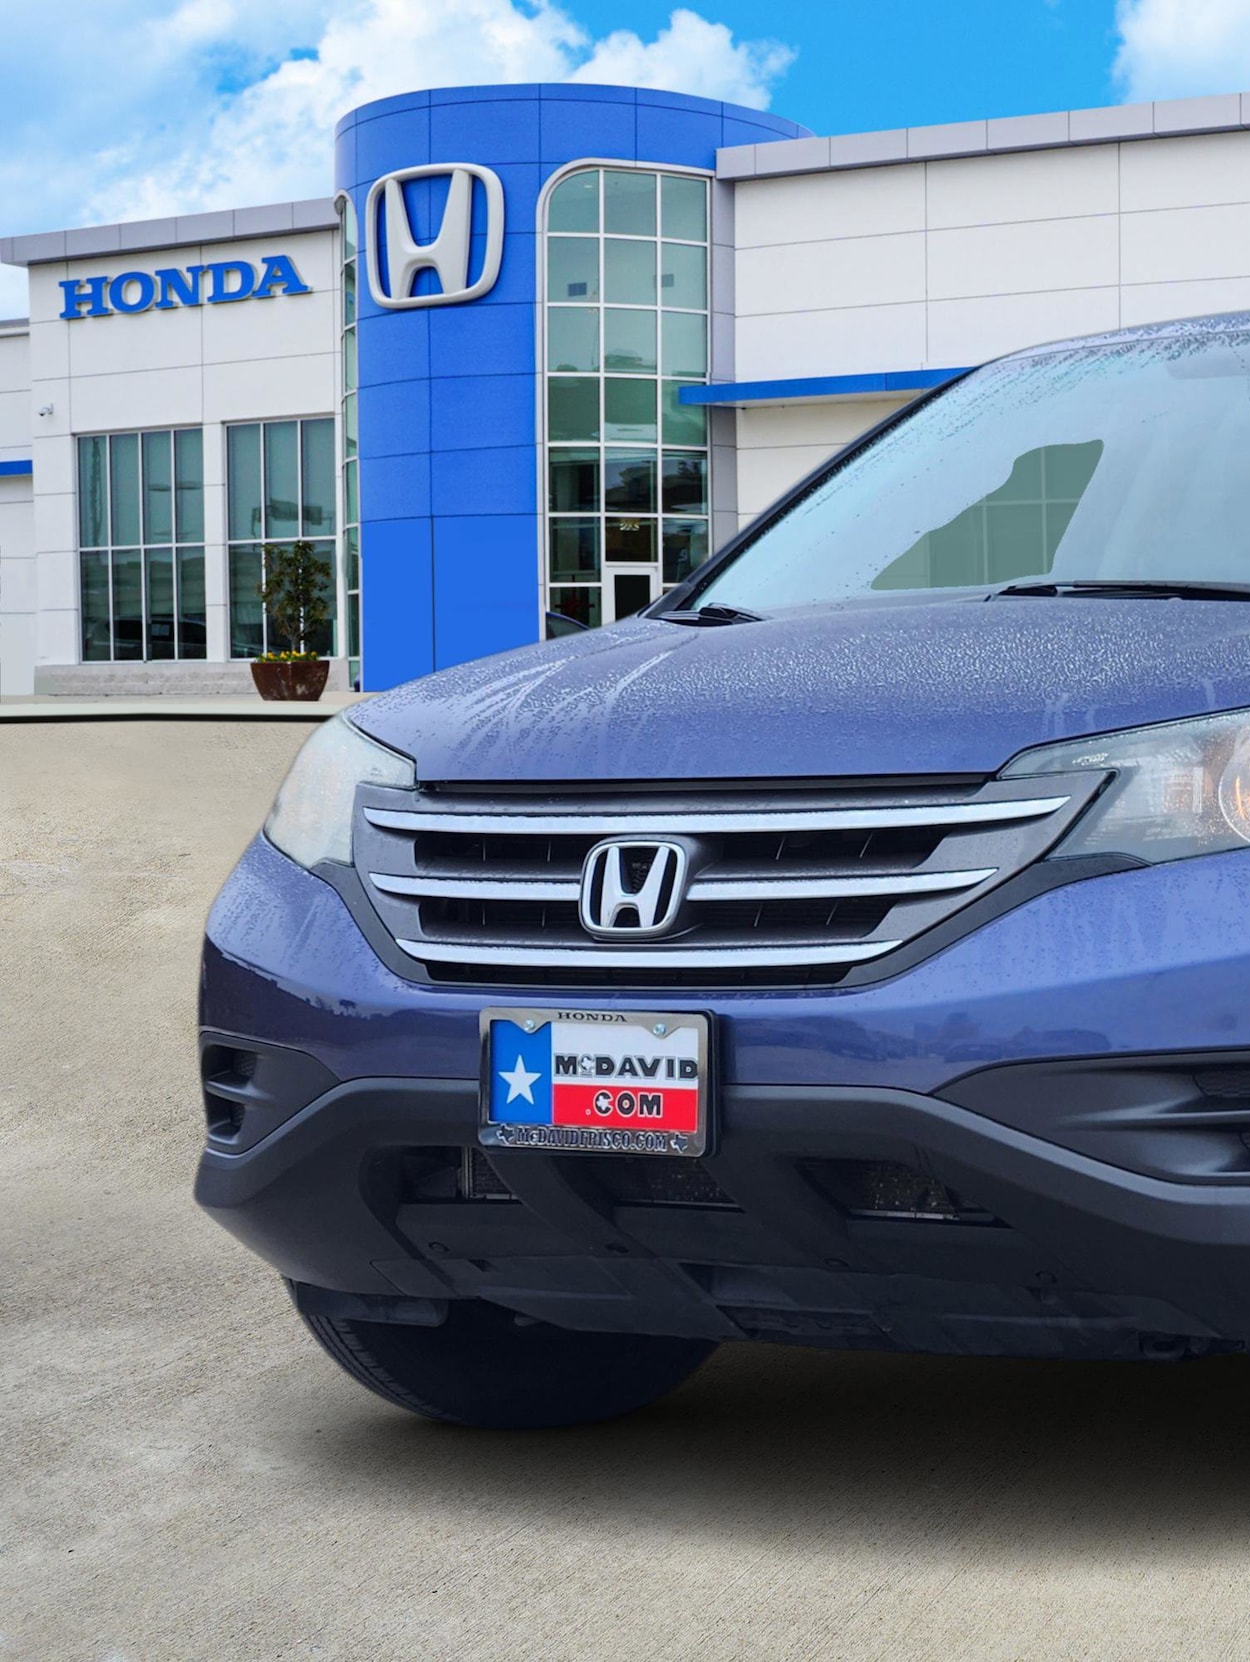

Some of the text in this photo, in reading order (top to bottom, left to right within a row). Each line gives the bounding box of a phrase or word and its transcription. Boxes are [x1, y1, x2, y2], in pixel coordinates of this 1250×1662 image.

[59, 255, 310, 320] HONDA
[557, 1011, 628, 1023] HONDA
[553, 1052, 698, 1080] McDAVID
[585, 1089, 664, 1118] .COM
